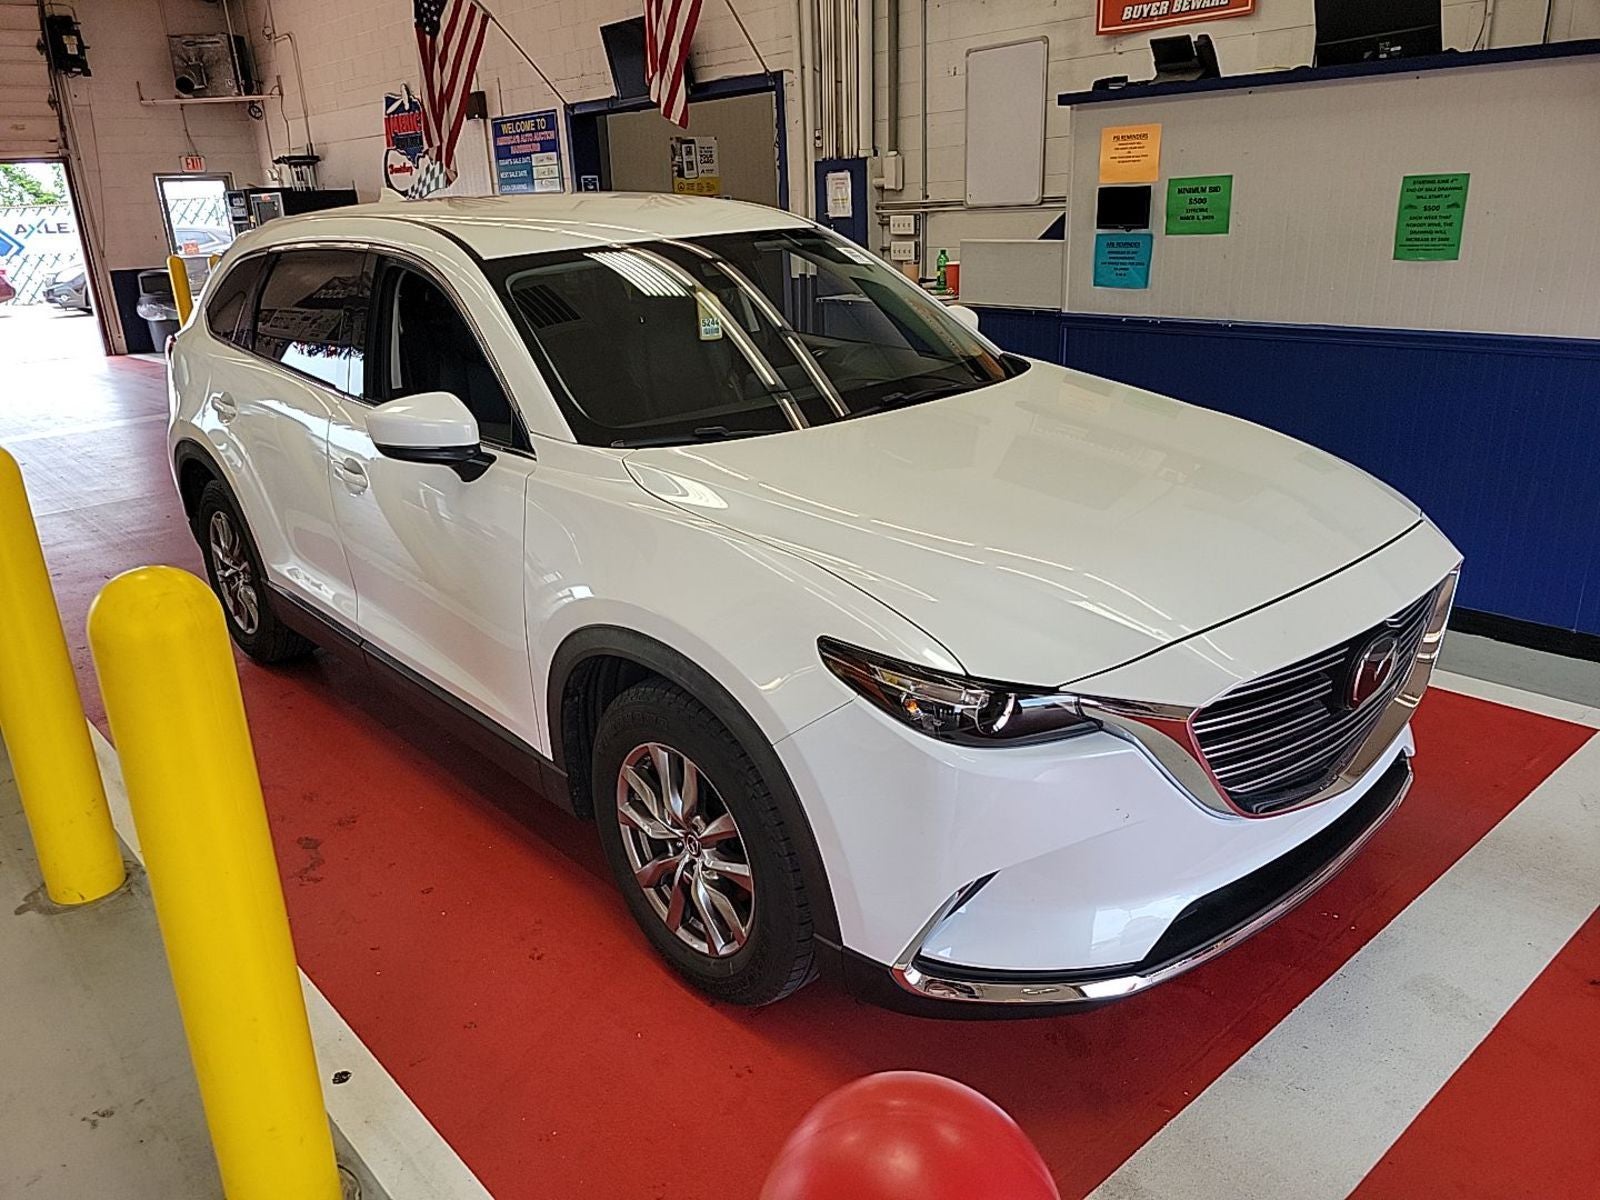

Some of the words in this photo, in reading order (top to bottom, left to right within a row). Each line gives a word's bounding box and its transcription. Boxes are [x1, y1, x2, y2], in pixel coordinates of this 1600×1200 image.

[1122, 5, 1169, 21] BUYER
[501, 120, 536, 135] WELCOME
[536, 117, 547, 129] TO
[186, 157, 203, 170] EXIT
[1177, 186, 1207, 194] MINIMUM
[1208, 185, 1222, 193] BID
[1188, 197, 1208, 205] $500
[15, 218, 71, 240] AXLE
